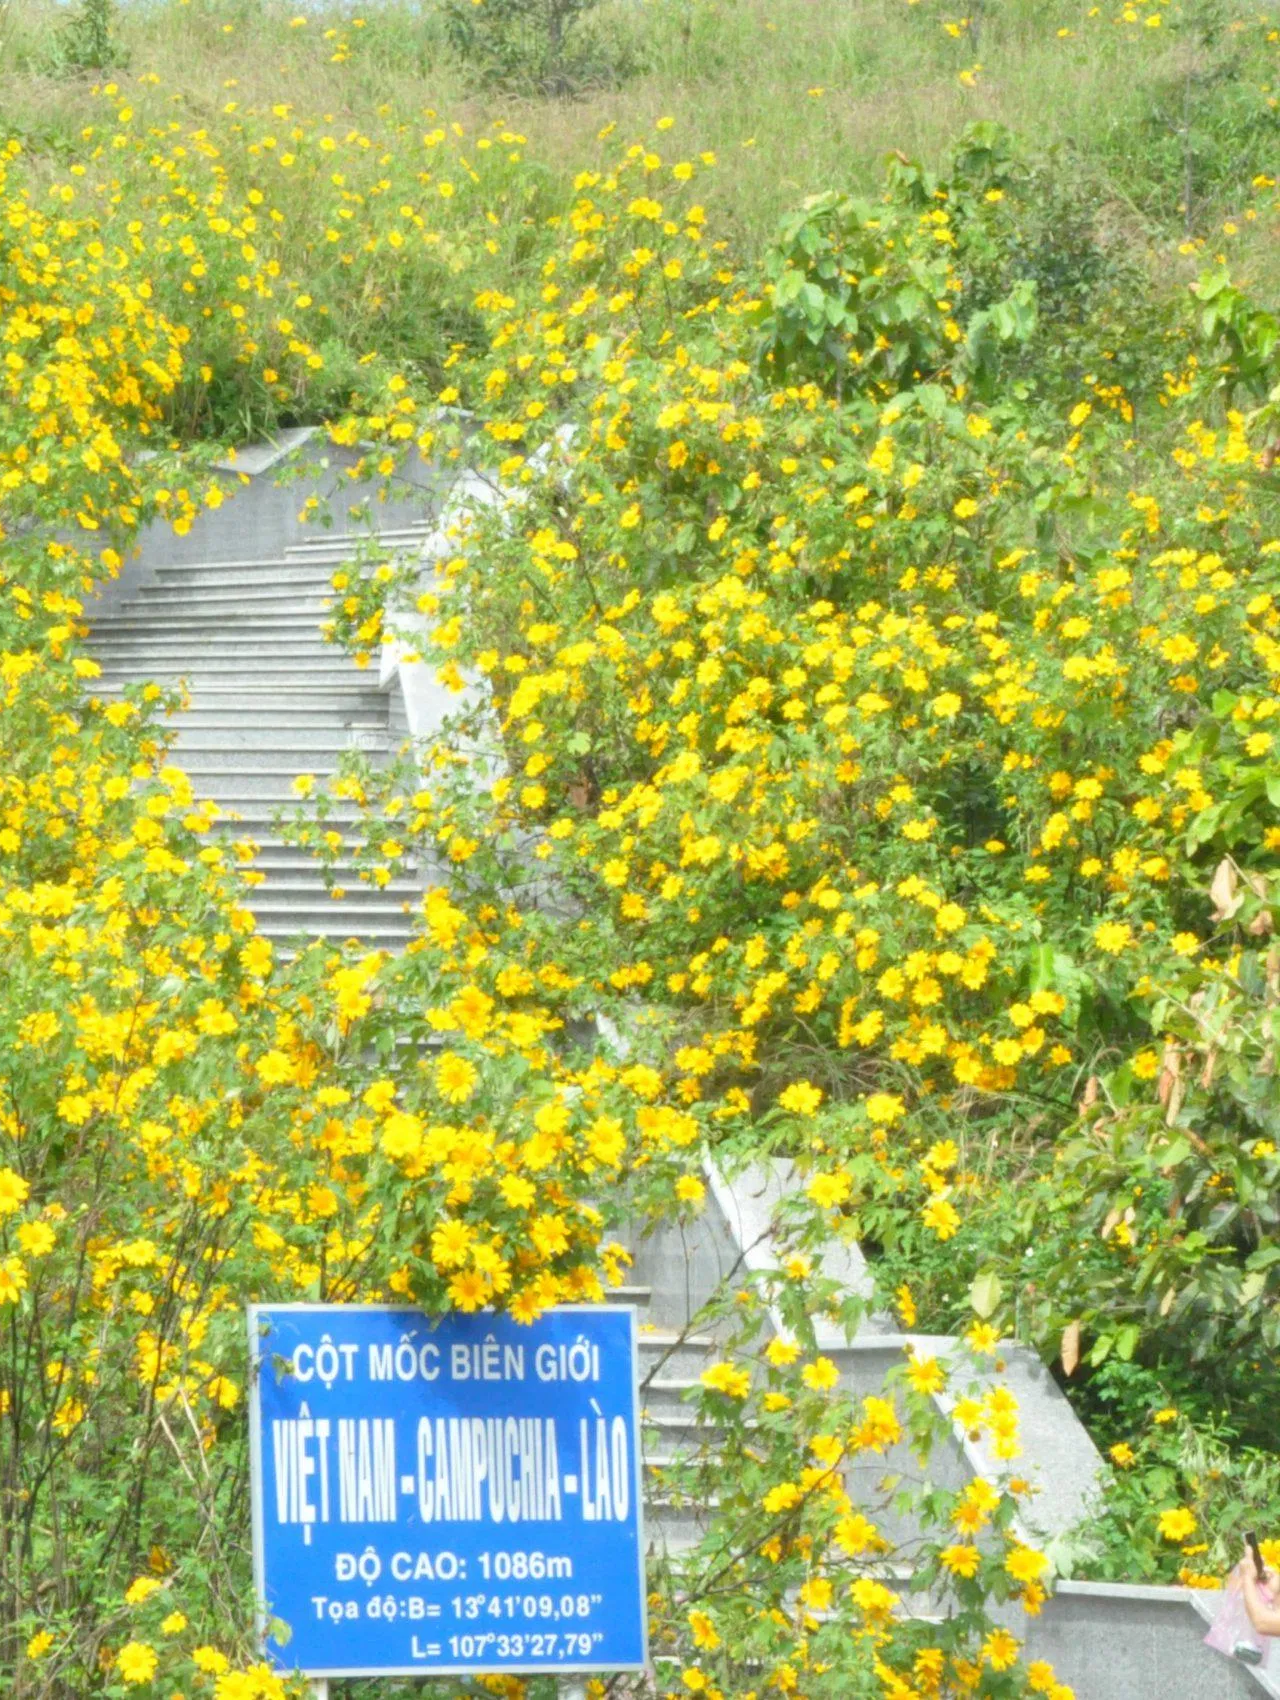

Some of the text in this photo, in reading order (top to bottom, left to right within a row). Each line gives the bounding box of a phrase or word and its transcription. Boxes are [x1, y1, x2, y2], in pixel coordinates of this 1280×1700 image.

[292, 1330, 600, 1390] CỘT MỐC BIÊN GIỚI
[272, 1400, 331, 1546] VIỆT
[335, 1545, 573, 1588] ĐỘ CAO: 1086m
[311, 1596, 360, 1625] Tọa
[411, 1635, 442, 1658] L=
